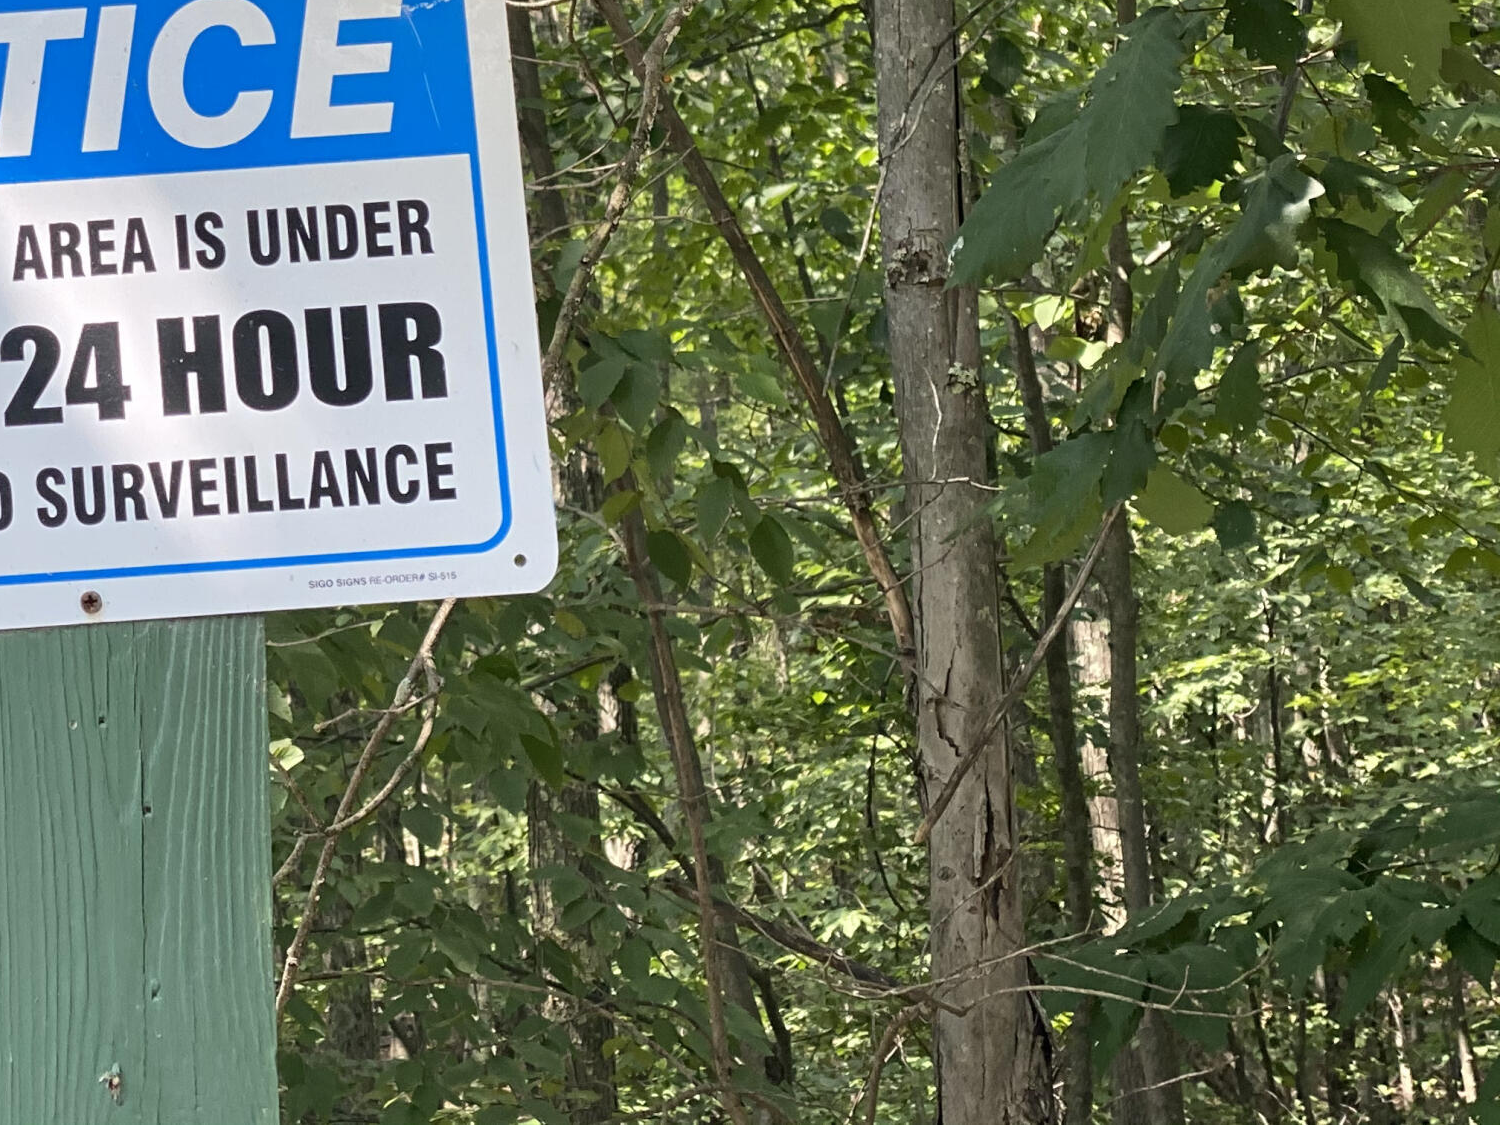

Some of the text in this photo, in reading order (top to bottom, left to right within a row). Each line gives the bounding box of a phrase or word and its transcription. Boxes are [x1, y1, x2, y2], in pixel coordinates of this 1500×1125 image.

[13, 217, 155, 281] AREA
[175, 211, 226, 269] IS
[246, 199, 434, 266] UNDER
[0, 302, 448, 427] 24 HOUR
[36, 442, 457, 528] SURVEILLANCE
[308, 571, 457, 589] SIGO SIGNS RE-ORDER# SI-515
